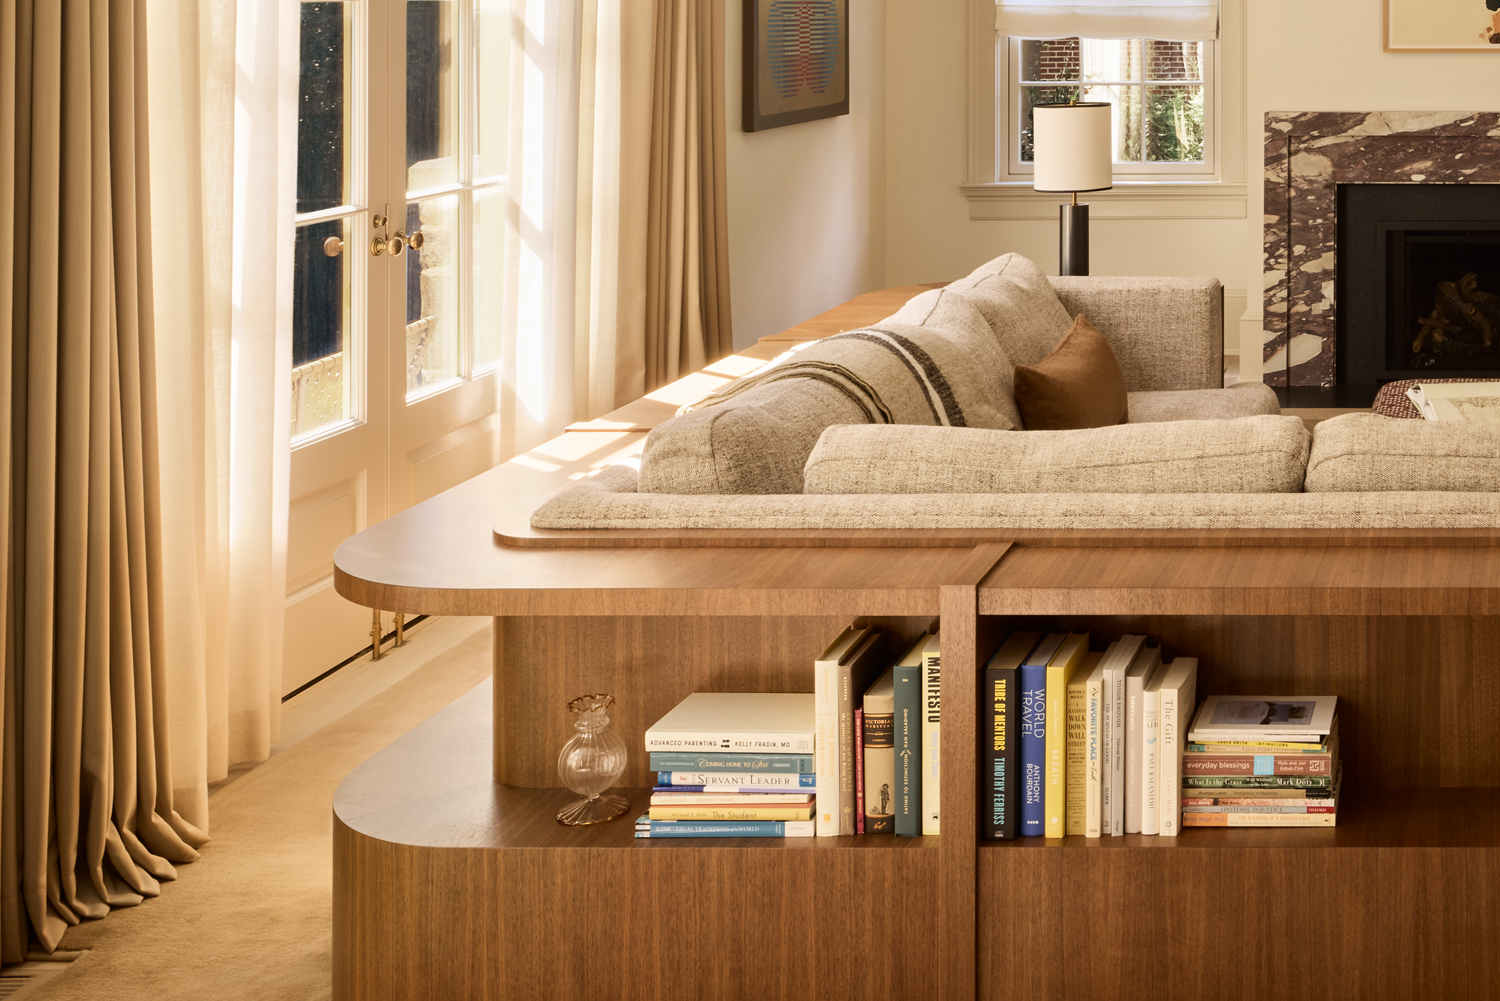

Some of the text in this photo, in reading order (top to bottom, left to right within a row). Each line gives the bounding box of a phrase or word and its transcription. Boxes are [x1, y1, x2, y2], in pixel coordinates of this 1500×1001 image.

[994, 679, 1006, 750] TRIBE OF MENTORS
[1022, 690, 1032, 738] TRAVEL
[1034, 689, 1045, 738] WORLD
[1165, 700, 1174, 744] The Gift
[698, 774, 790, 785] SERVANT LEADER
[994, 757, 1005, 791] TIMOTHY
[993, 794, 1004, 825] FERRISS
